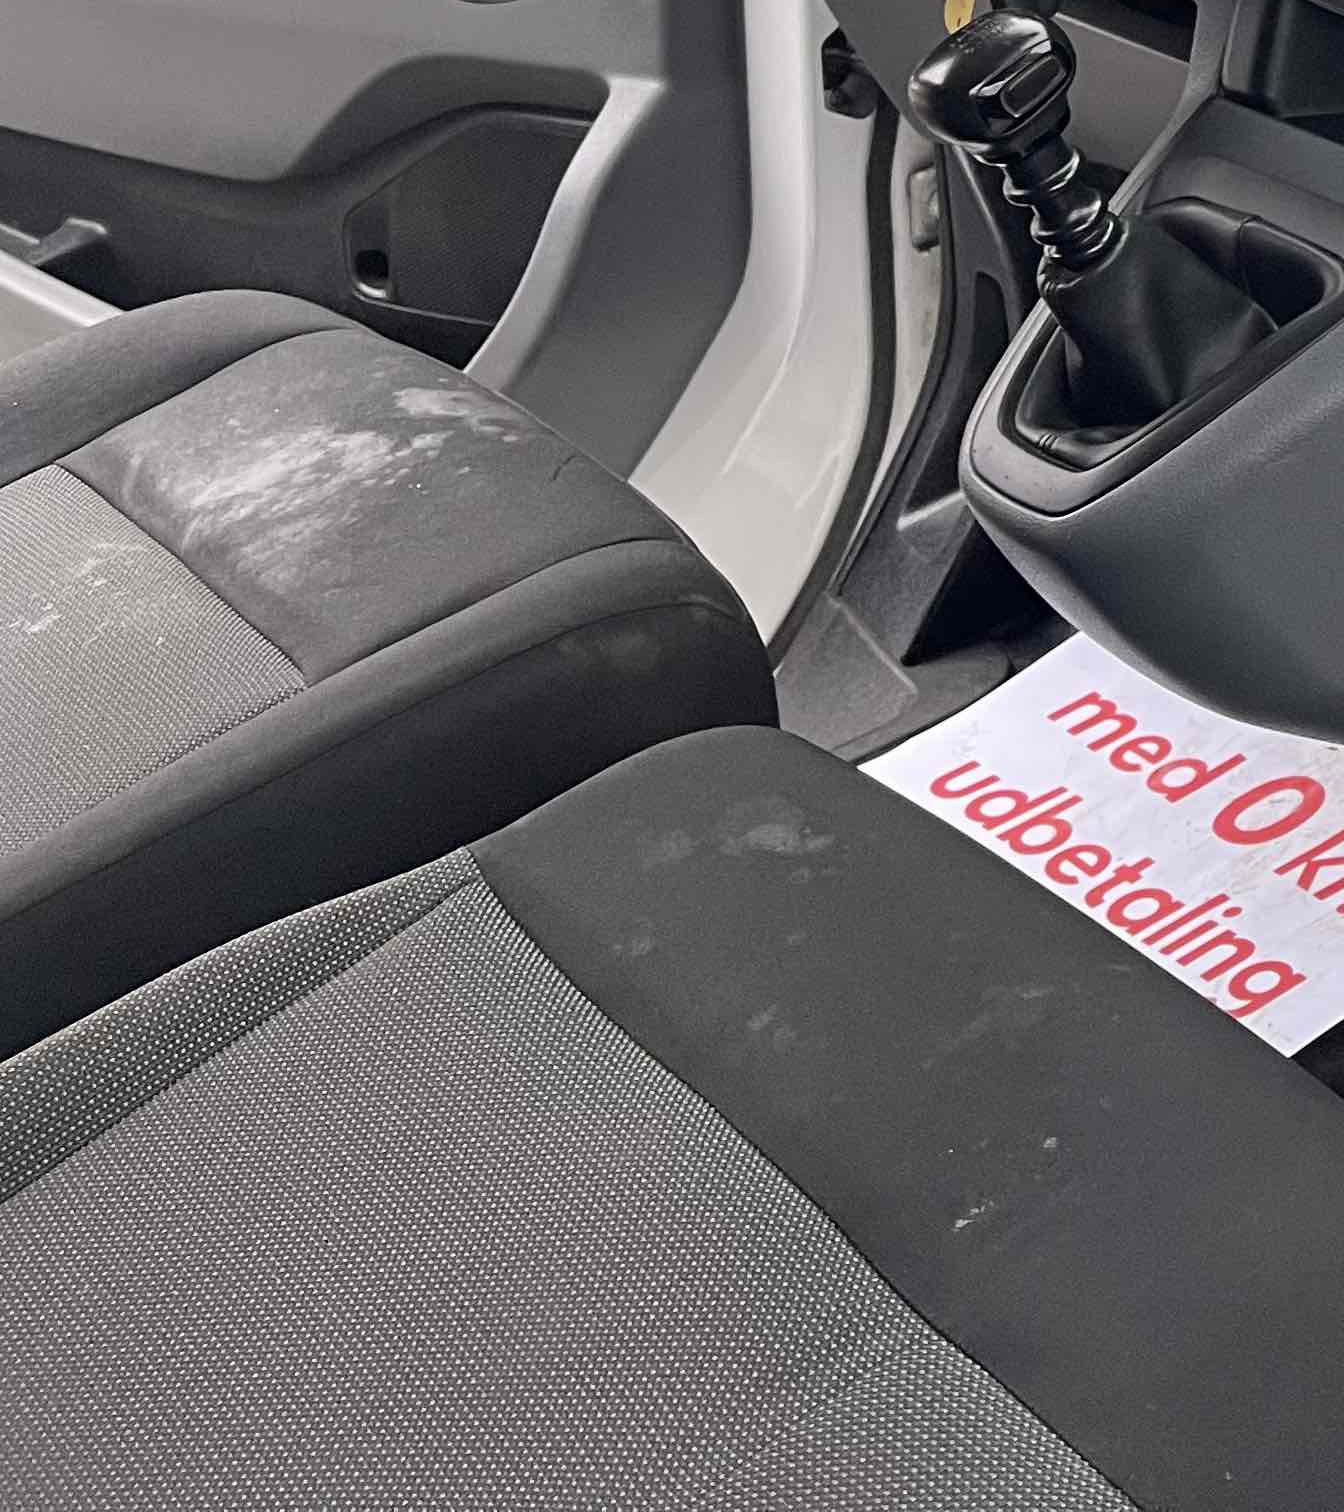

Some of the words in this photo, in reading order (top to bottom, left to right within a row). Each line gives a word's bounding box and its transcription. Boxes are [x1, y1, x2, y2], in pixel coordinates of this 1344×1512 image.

[1047, 690, 1246, 805] med
[1212, 775, 1328, 847] 0
[929, 759, 1307, 1021] udbetaling
